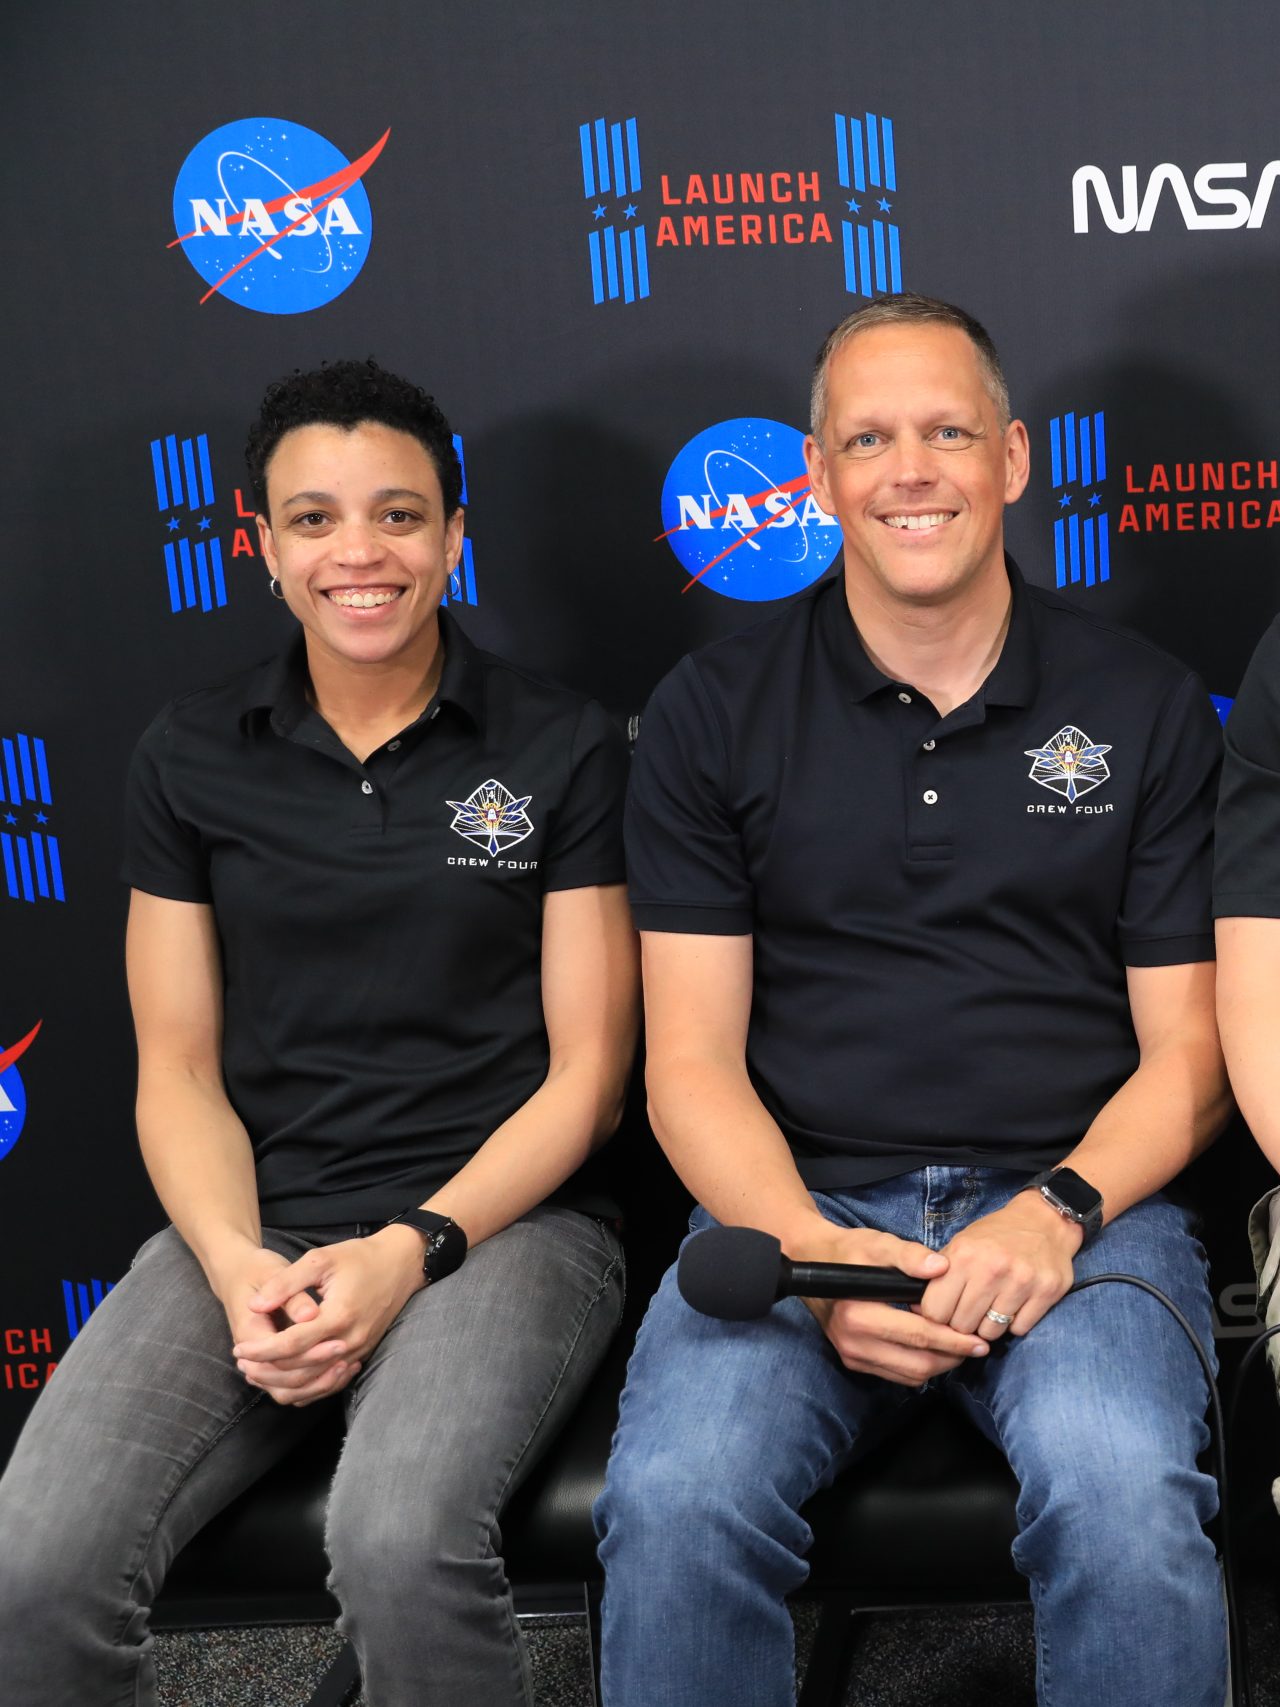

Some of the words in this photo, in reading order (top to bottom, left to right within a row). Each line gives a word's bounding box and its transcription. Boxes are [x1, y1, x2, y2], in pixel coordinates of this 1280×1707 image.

[661, 171, 821, 206] LAUNCH
[189, 197, 365, 237] NASA
[655, 211, 833, 247] AMERICA
[1125, 460, 1278, 493] LAUNCH
[676, 491, 840, 531] NASA
[1026, 804, 1067, 814] CREW
[1075, 803, 1114, 814] FOUR
[447, 856, 489, 867] CREW
[497, 860, 538, 870] FOUR
